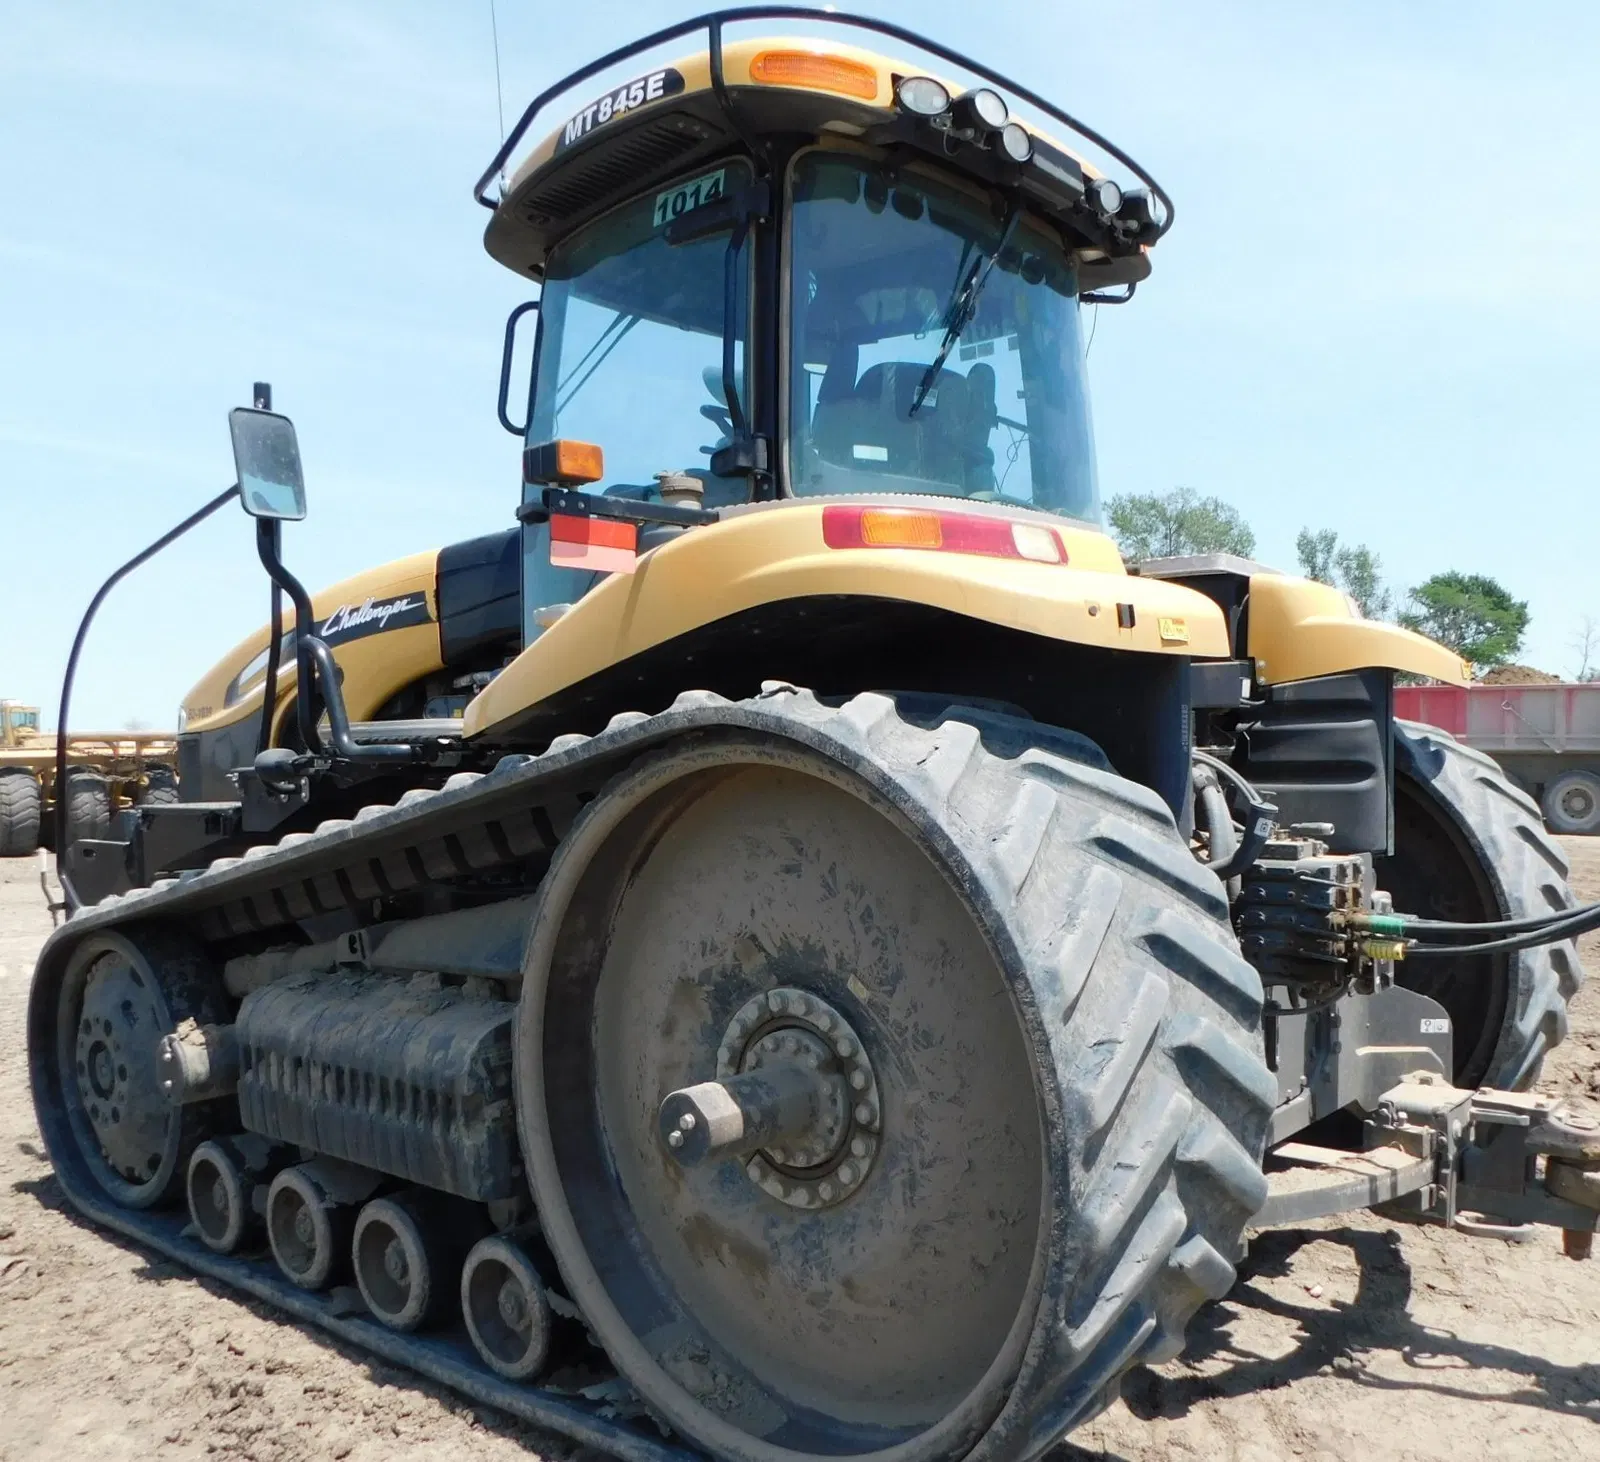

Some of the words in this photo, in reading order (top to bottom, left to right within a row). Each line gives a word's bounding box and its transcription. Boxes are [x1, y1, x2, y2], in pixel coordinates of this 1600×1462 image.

[565, 71, 666, 145] MT845E
[657, 176, 721, 222] 1014
[321, 595, 425, 637] Challenger
